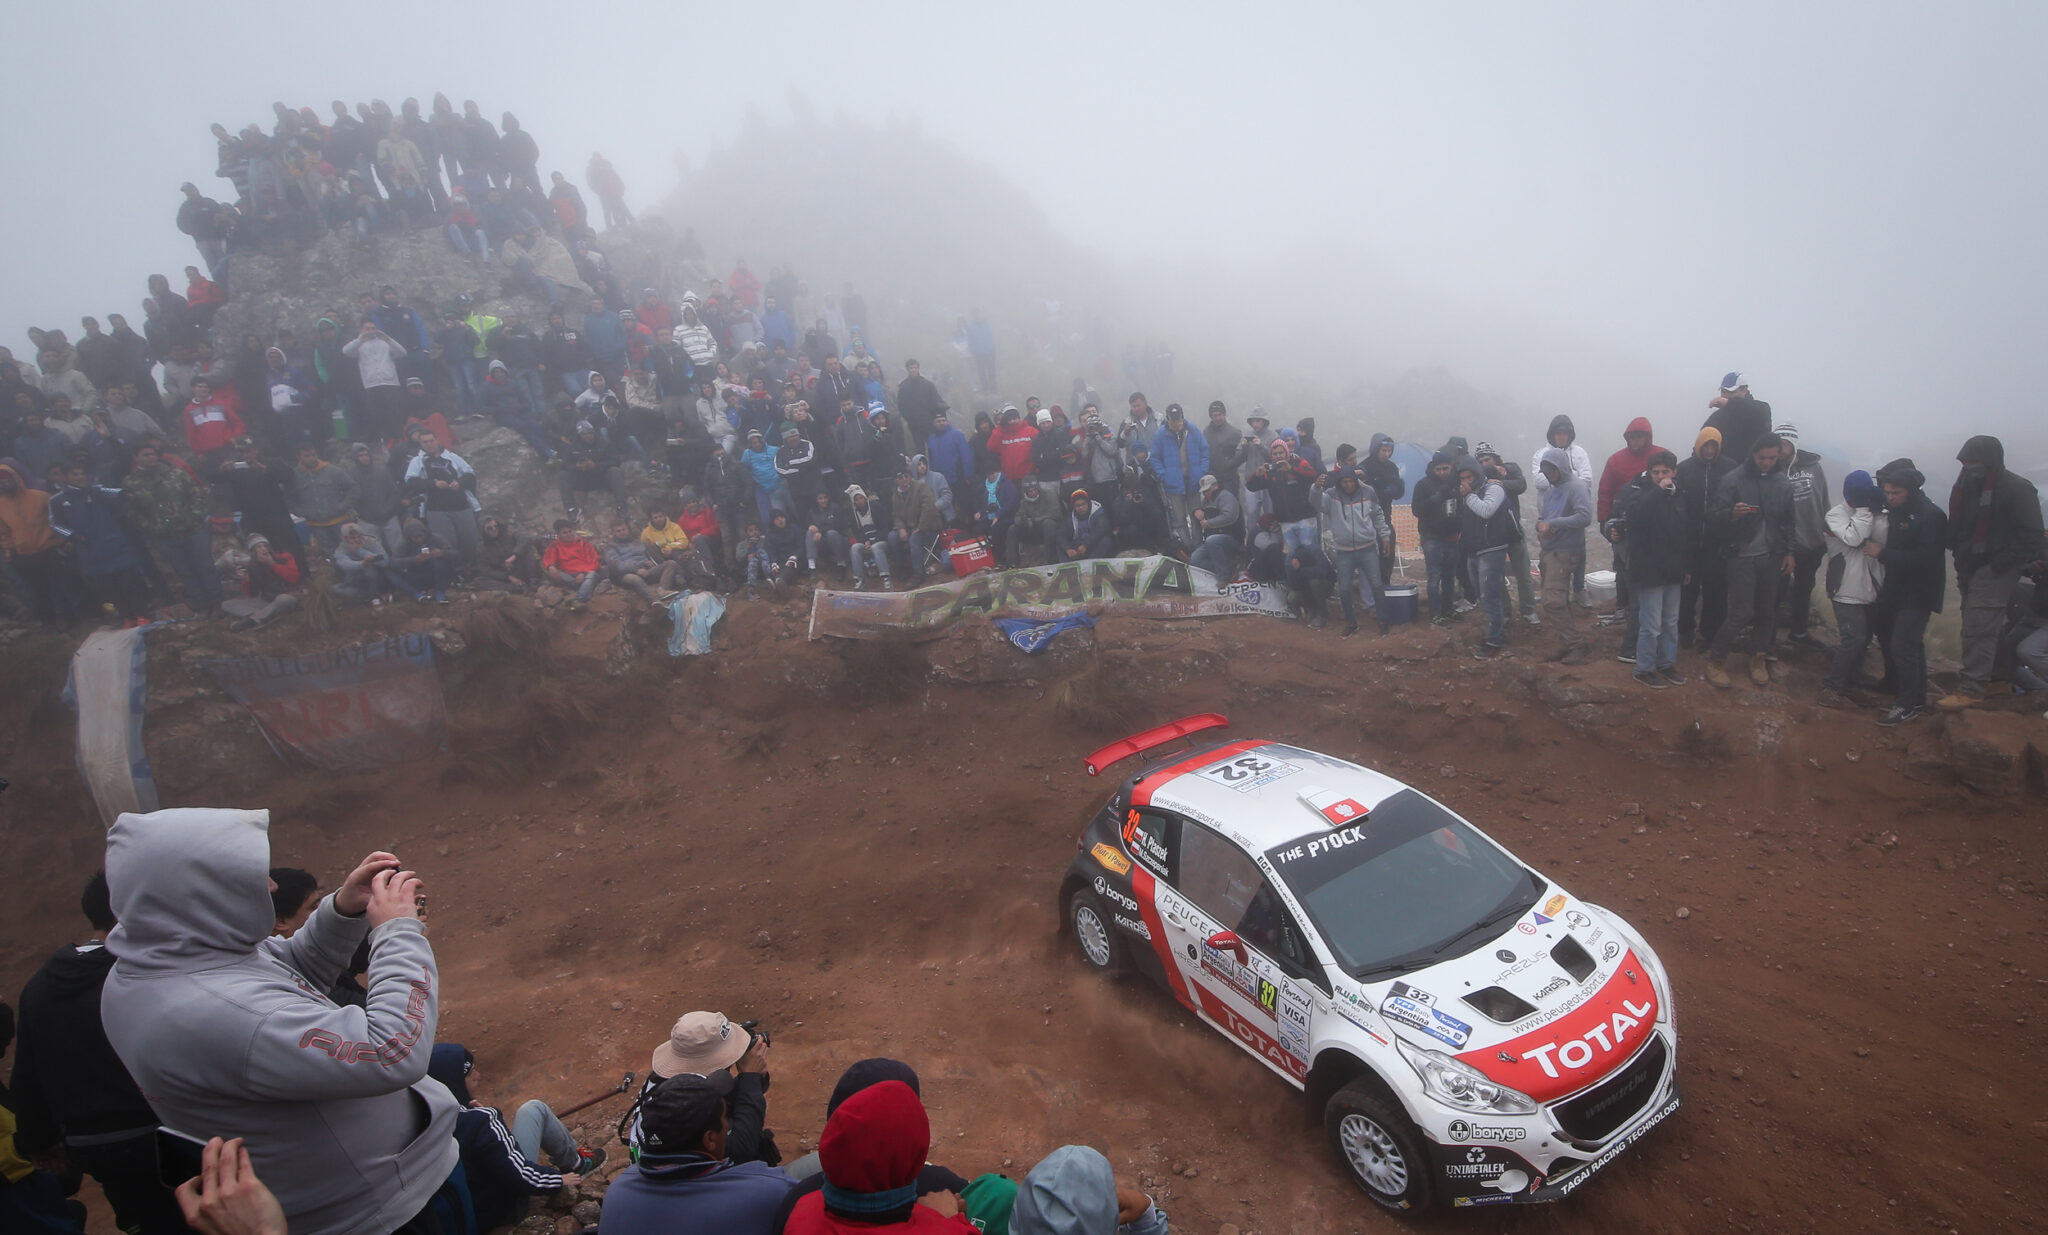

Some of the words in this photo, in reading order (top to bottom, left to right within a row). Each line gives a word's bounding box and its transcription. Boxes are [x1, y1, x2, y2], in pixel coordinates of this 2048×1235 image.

[1209, 758, 1271, 781] 32
[1122, 808, 1141, 843] 32
[1277, 843, 1304, 865] THE
[1106, 884, 1138, 911] borygo
[1163, 894, 1218, 939] PEUGEO
[1214, 938, 1237, 946] TOTAL
[1260, 980, 1274, 1010] 32
[1410, 989, 1429, 1003] 32
[1512, 971, 1609, 1034] www.peugeot-sport.sk
[1283, 1003, 1306, 1027] VISA
[1338, 1005, 1374, 1032] PEUGEOT
[1388, 1003, 1430, 1026] Argentina
[1221, 1007, 1303, 1078] TOTAL
[1522, 999, 1651, 1078] TOTAL
[1471, 1123, 1526, 1142] borygo
[1560, 1168, 1591, 1195] TAGAI
[1591, 1141, 1626, 1173] RACING
[1626, 1098, 1681, 1145] TECHNOLOGY
[1446, 1163, 1505, 1175] UNIMETALEX
